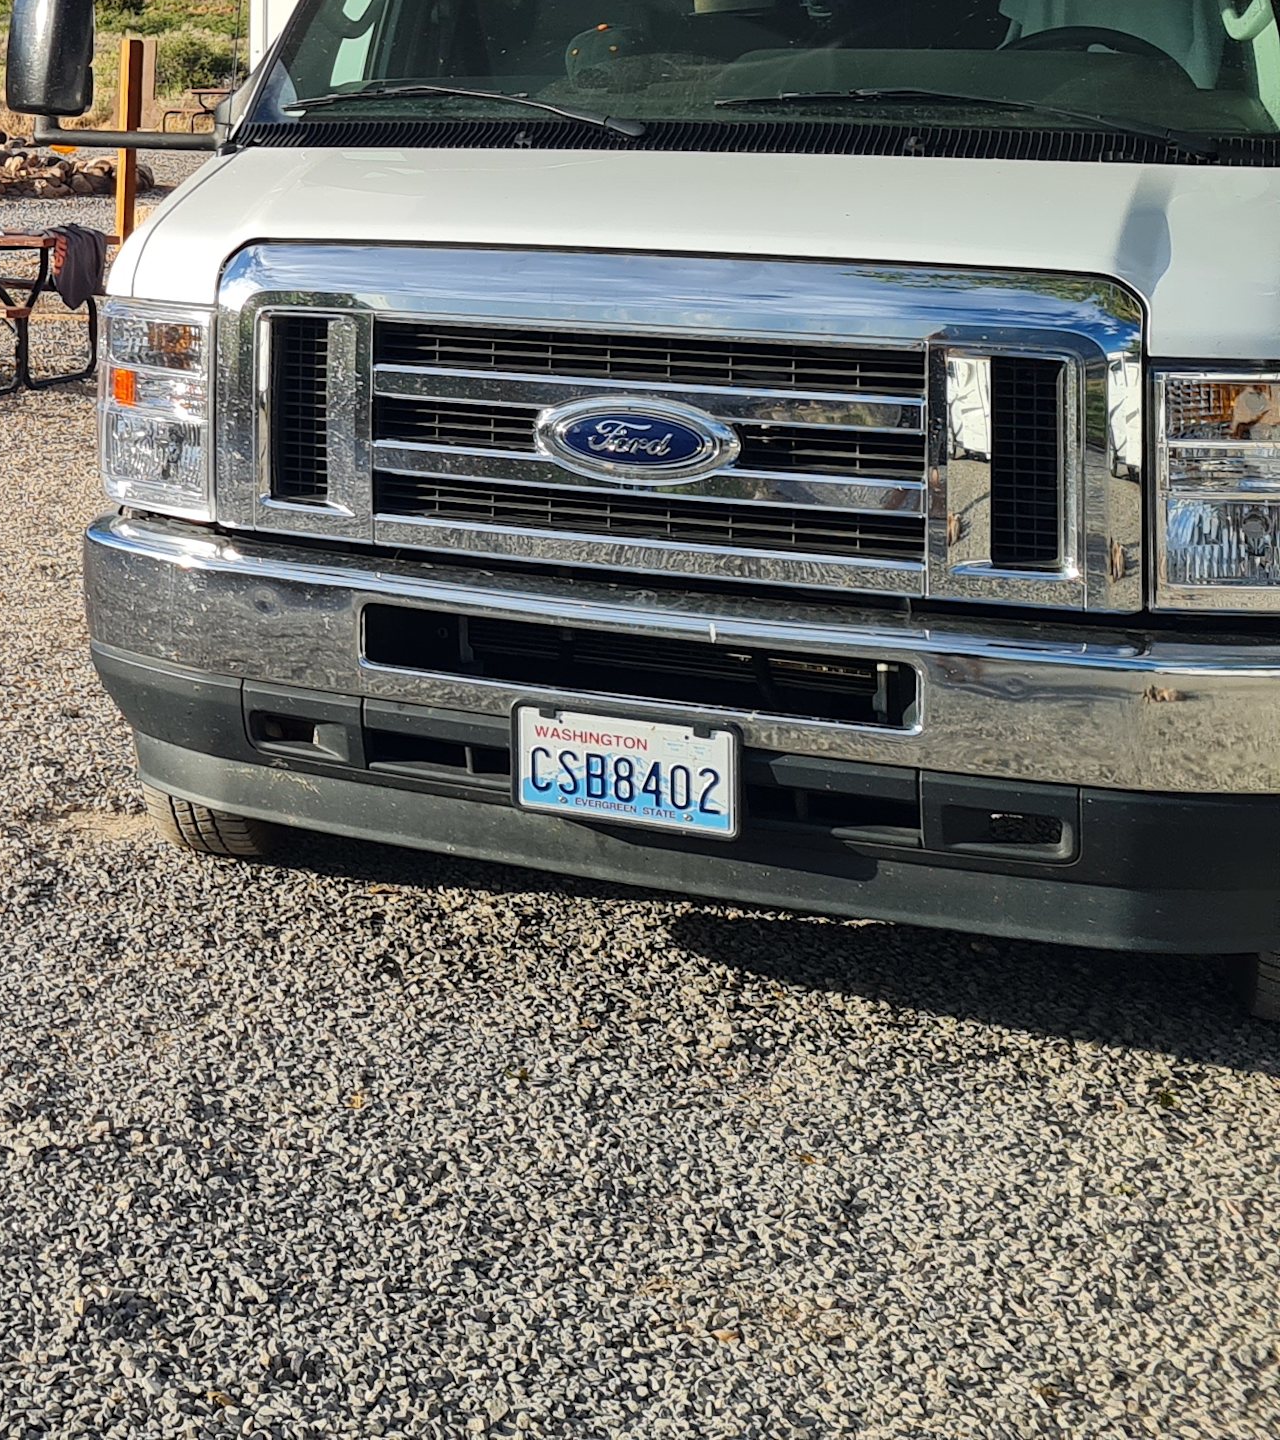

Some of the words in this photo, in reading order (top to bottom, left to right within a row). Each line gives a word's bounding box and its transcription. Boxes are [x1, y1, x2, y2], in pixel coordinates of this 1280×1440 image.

[588, 419, 673, 456] Ford
[534, 725, 648, 751] WASHINGTON
[531, 747, 721, 814] CSB8402
[575, 797, 637, 814] EVERGREEN
[642, 807, 676, 820] STATE
